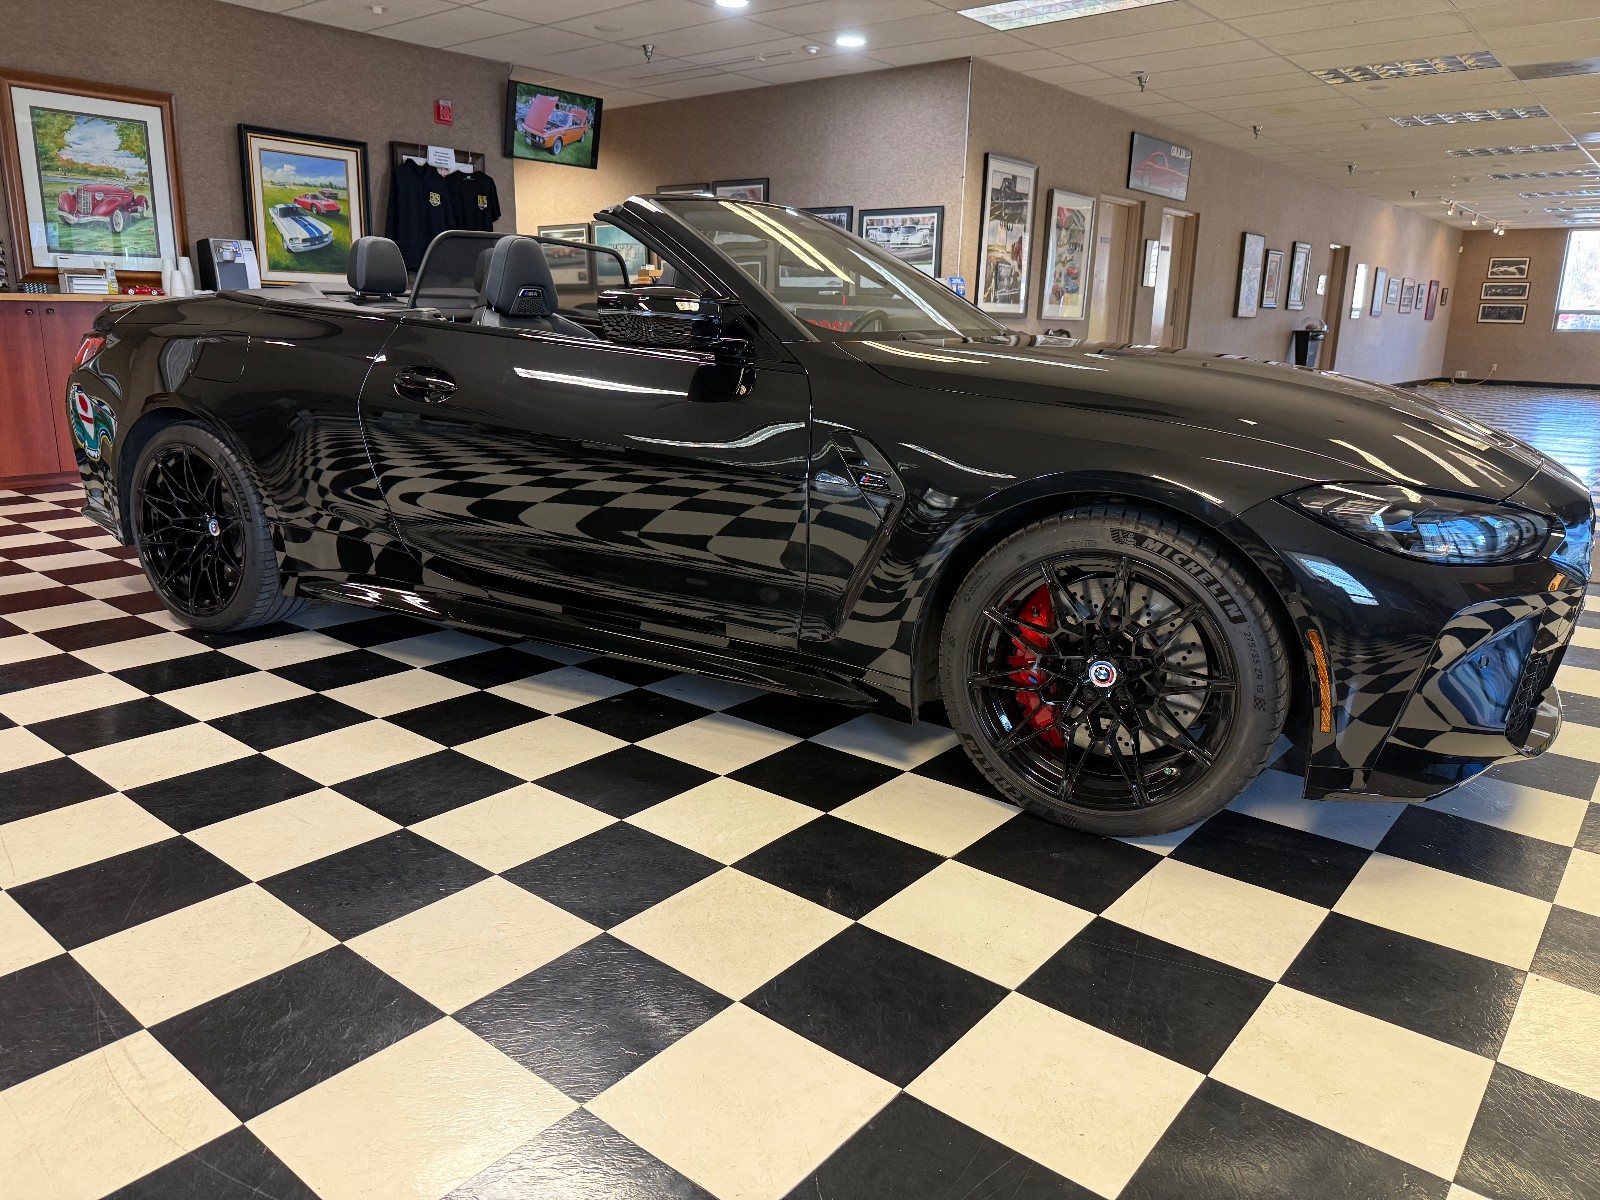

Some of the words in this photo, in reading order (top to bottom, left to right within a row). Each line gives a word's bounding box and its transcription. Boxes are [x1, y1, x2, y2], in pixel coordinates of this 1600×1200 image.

[1141, 537, 1246, 618] MICHELIN
[1243, 631, 1261, 665] 275/35
[1254, 667, 1263, 680] ZR
[1256, 684, 1264, 693] 19
